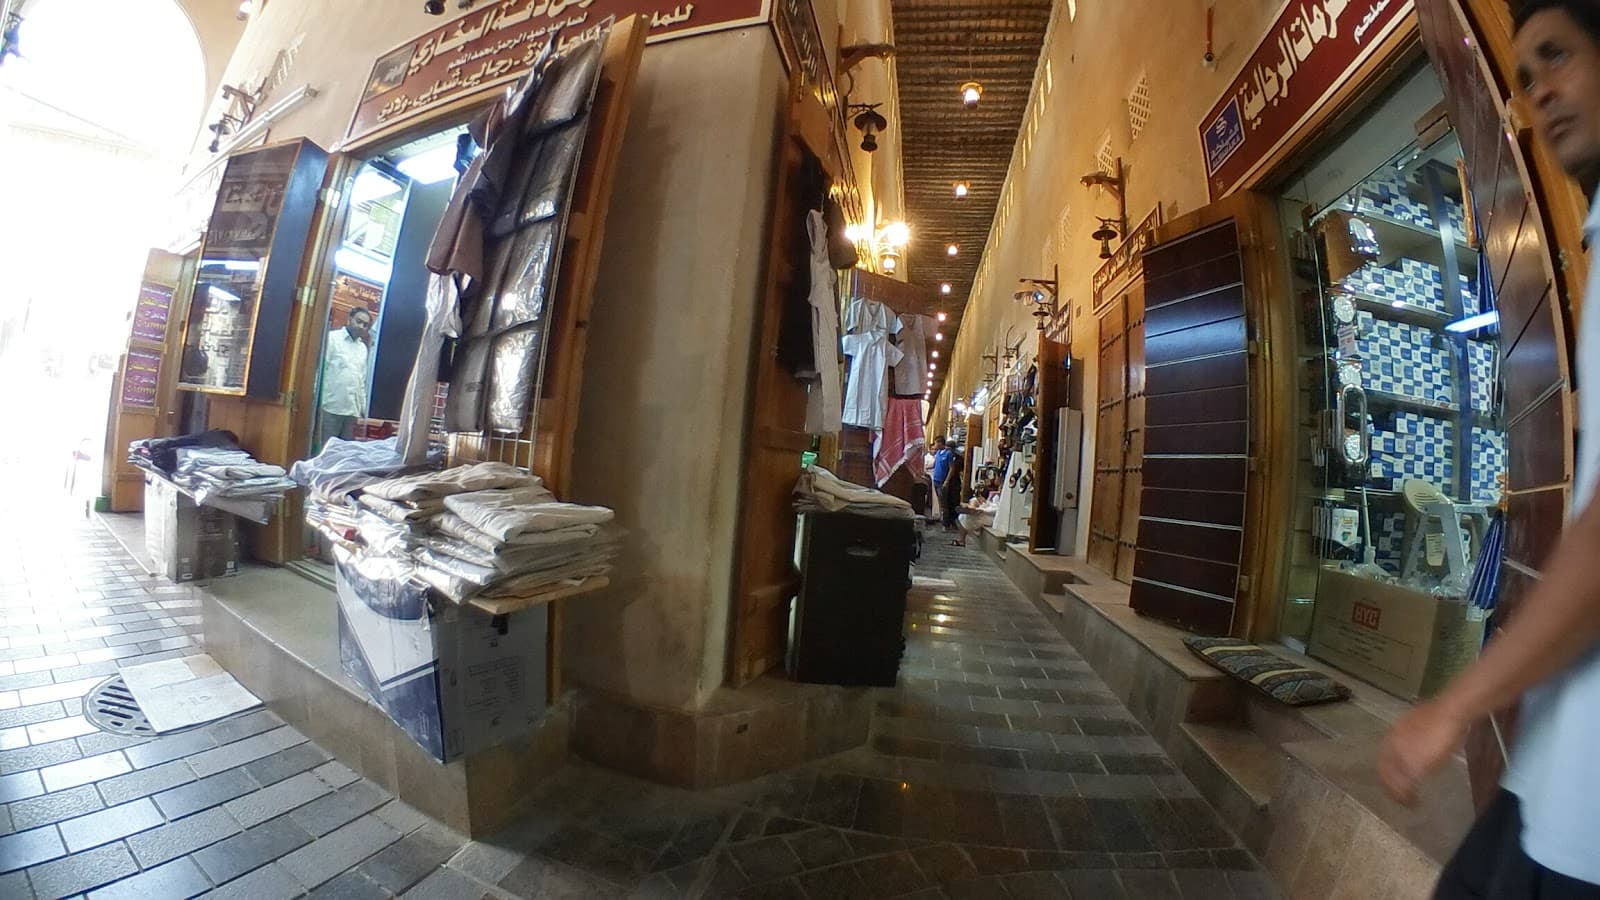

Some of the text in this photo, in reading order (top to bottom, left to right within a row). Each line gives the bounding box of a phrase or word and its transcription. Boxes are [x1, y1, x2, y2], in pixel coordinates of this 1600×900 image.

[649, 3, 694, 29] للملا
[1353, 0, 1391, 45] ملحم
[406, 8, 498, 76] البخاري
[463, 58, 513, 87] رجالي
[1239, 0, 1349, 131] مات الرجالية
